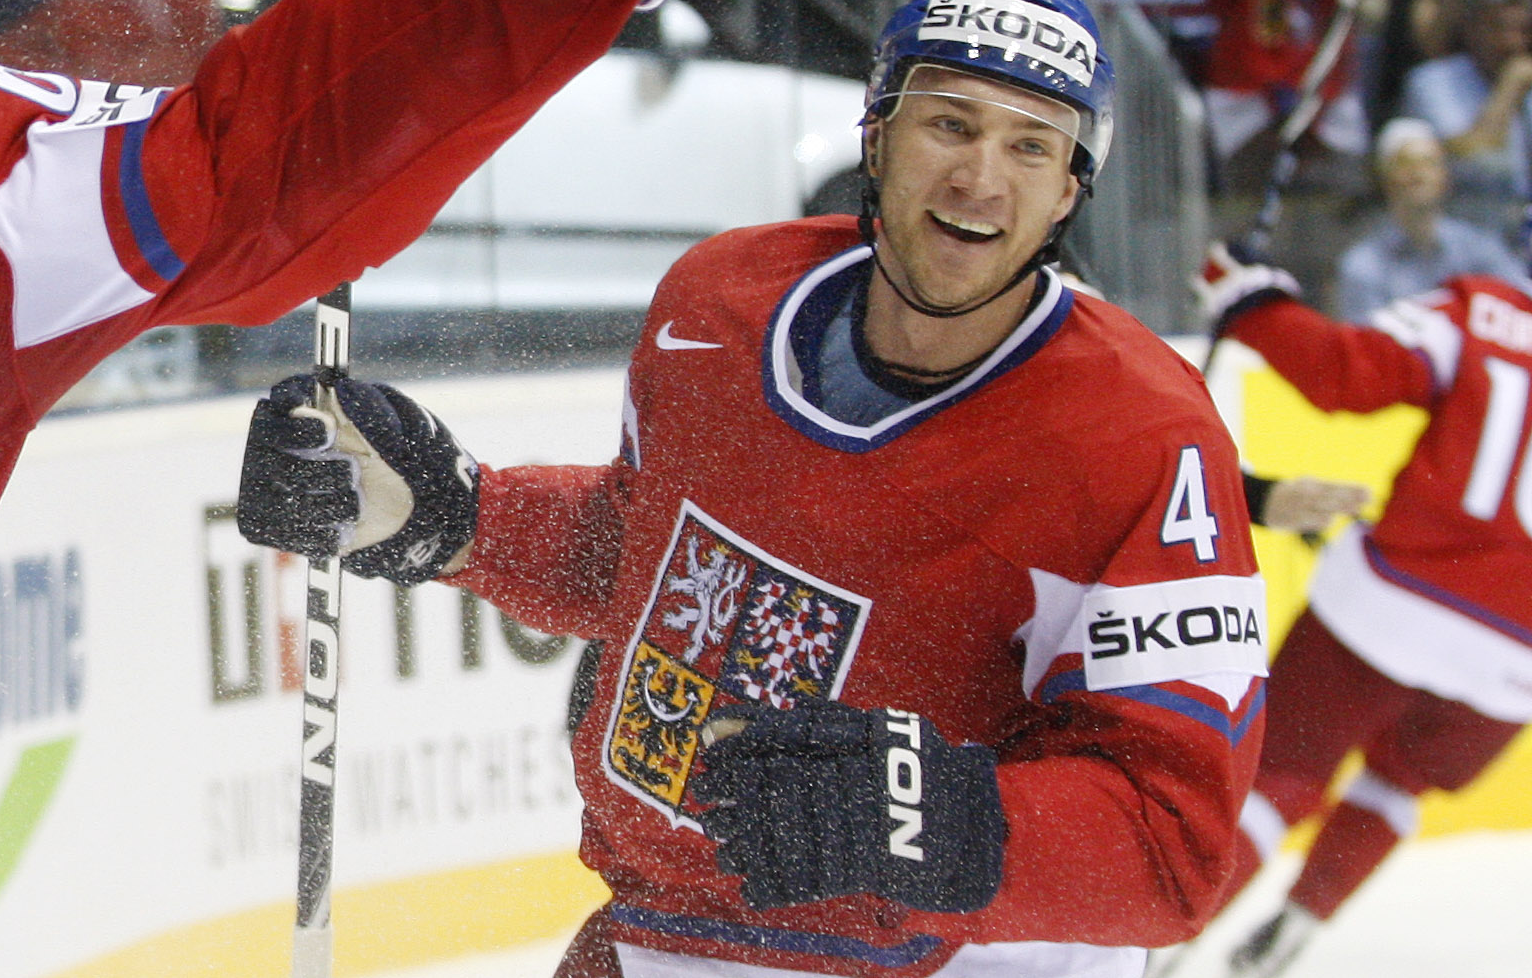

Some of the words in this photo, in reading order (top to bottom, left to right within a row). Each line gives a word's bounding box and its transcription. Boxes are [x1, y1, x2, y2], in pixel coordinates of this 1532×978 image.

[921, 0, 1093, 76] ŠKODA
[1160, 443, 1220, 564] 4
[1087, 607, 1262, 660] ŠKODA
[886, 707, 924, 862] TON
